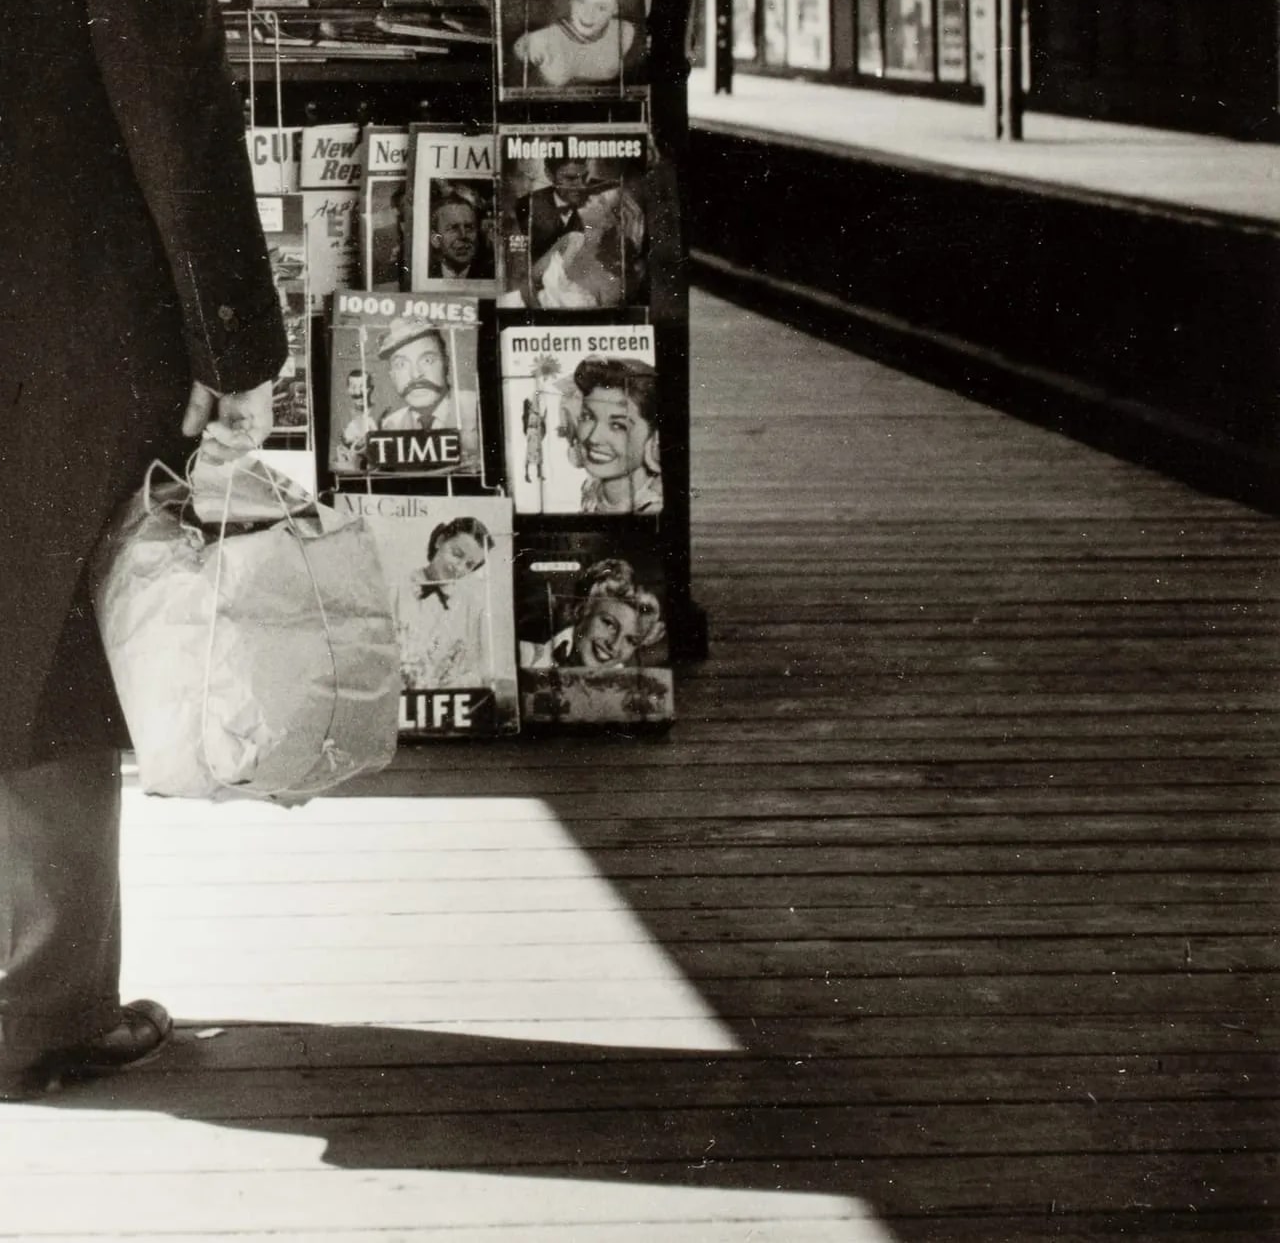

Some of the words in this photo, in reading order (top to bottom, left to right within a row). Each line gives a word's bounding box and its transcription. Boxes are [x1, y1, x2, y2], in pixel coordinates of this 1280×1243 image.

[311, 137, 356, 158] New
[429, 144, 491, 170] TIM
[507, 136, 563, 159] Modern
[567, 136, 641, 158] Romances
[338, 294, 396, 317] 1000
[401, 298, 478, 322] JOKES
[512, 336, 582, 353] modern
[587, 334, 649, 353] screen
[369, 435, 460, 464] TIME
[398, 694, 471, 729] LIFE
